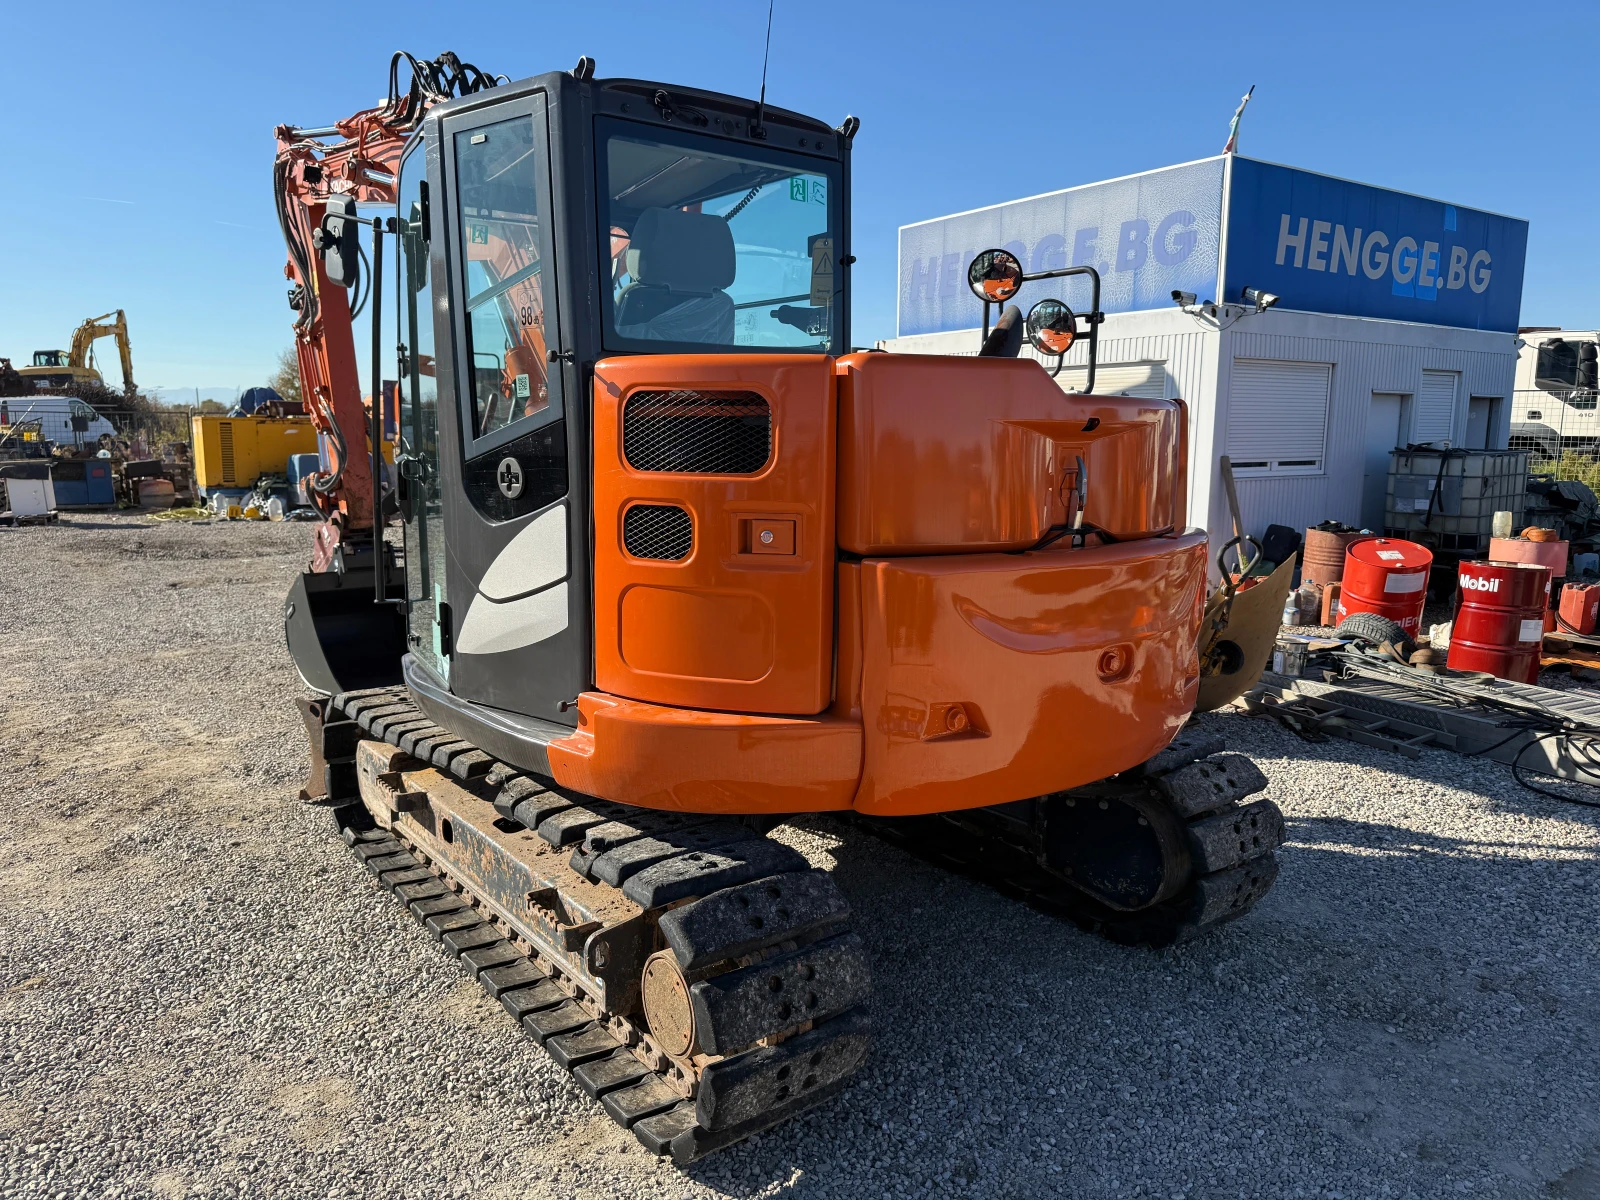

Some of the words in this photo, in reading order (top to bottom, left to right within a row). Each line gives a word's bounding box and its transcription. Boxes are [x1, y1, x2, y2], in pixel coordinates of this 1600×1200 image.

[1275, 213, 1492, 294] HENGGE.BG
[521, 306, 533, 326] 98
[1459, 573, 1500, 593] Mobil
